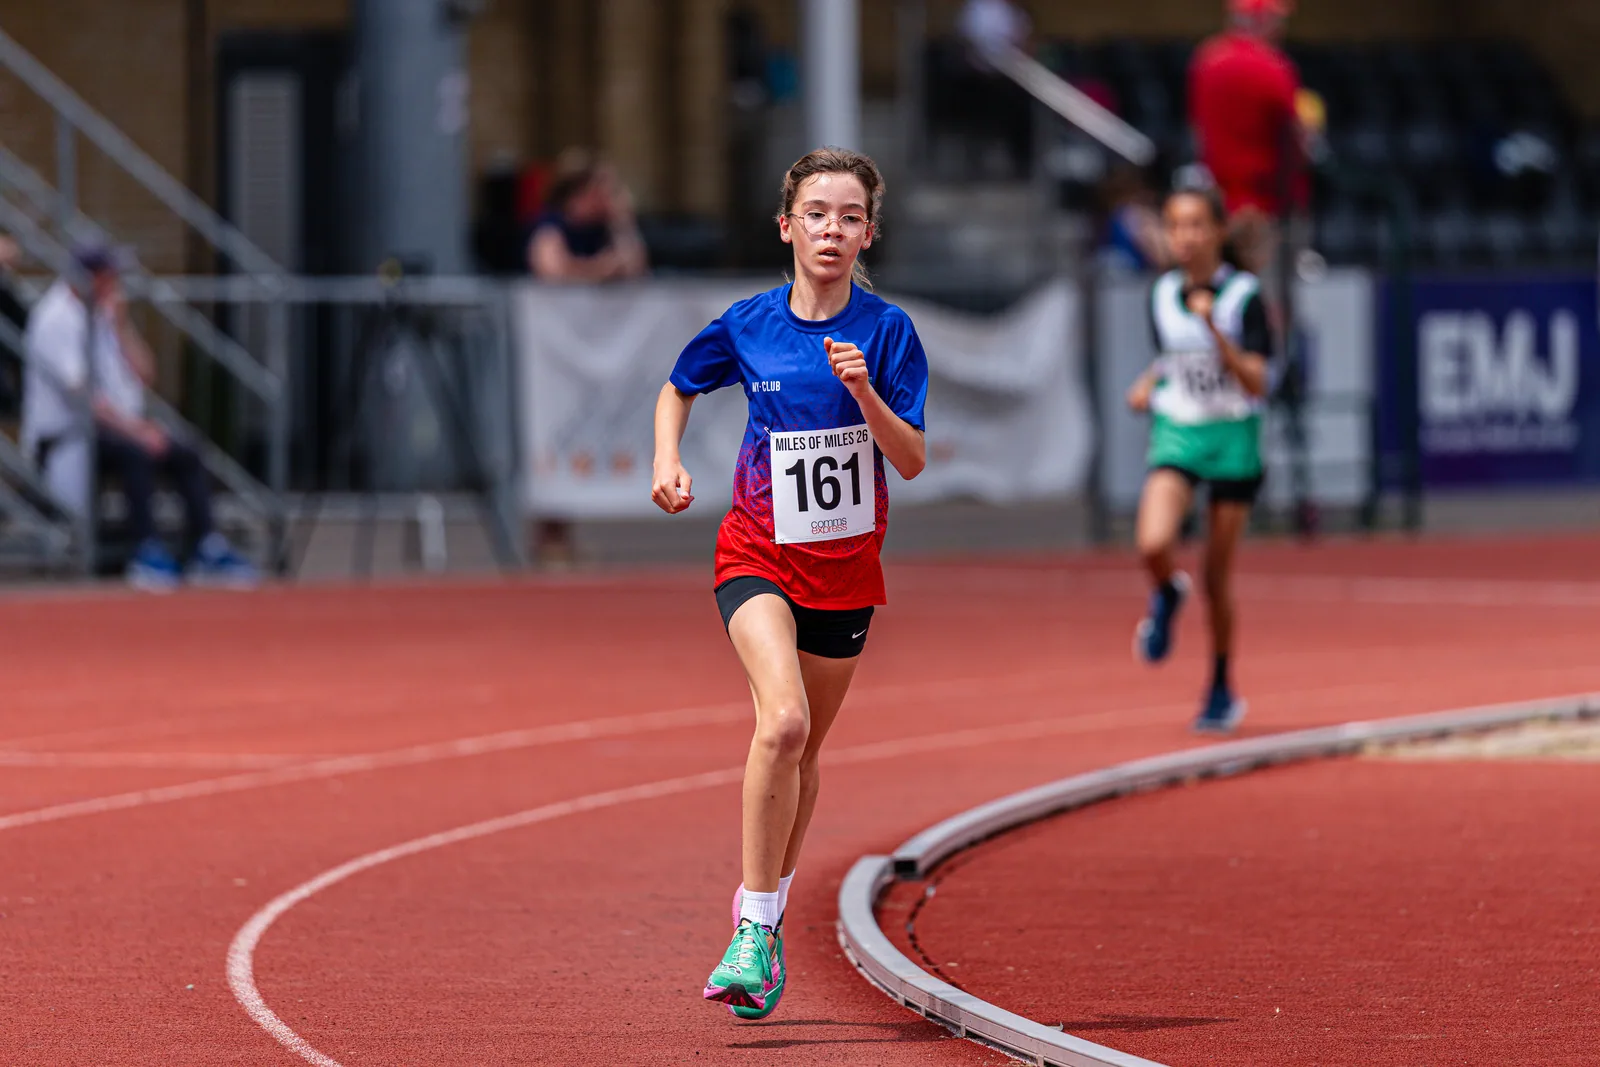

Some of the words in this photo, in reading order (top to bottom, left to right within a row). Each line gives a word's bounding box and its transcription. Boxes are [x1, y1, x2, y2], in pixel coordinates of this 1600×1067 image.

[775, 436, 806, 451] MILES
[809, 435, 821, 449] OF
[825, 432, 854, 448] MILES
[857, 429, 868, 443] 26
[785, 452, 861, 512] 161
[811, 517, 847, 528] comms
[812, 524, 847, 534] express
